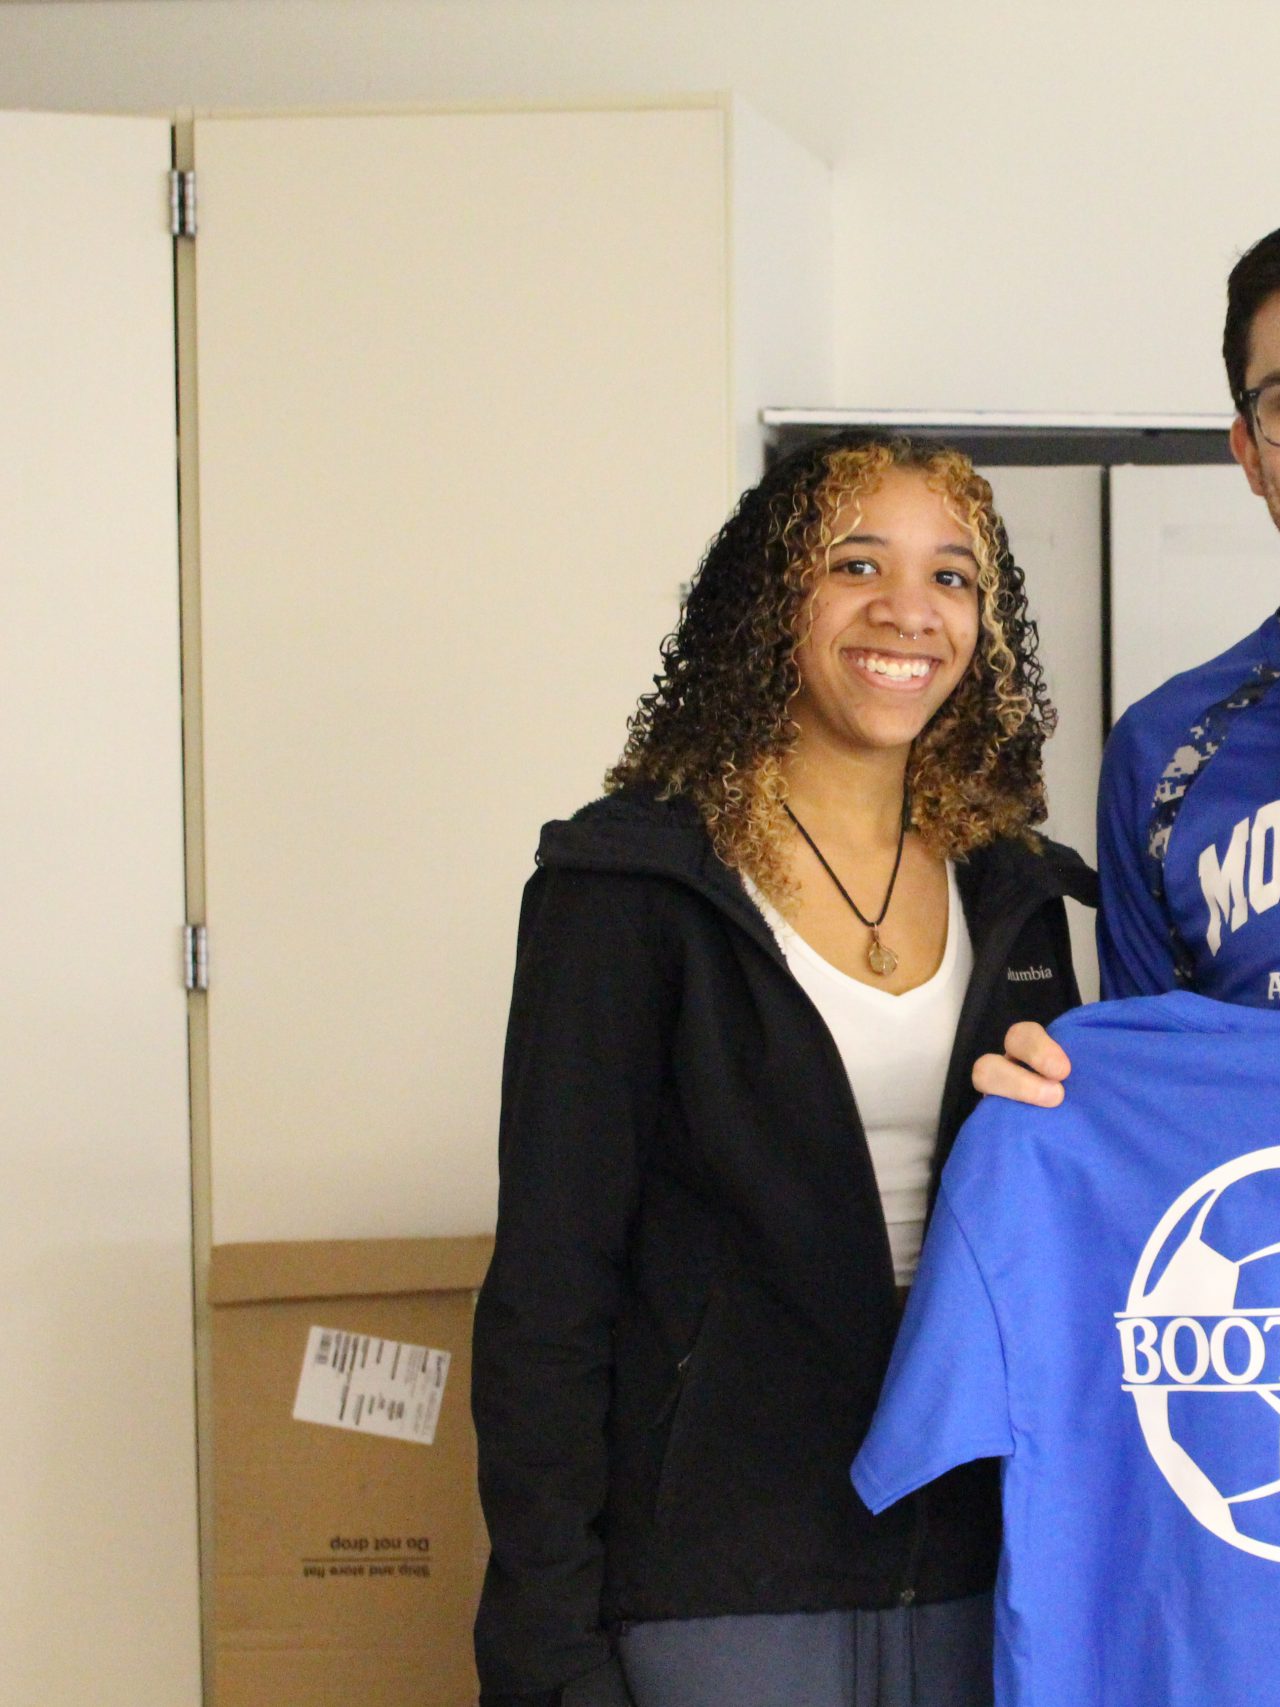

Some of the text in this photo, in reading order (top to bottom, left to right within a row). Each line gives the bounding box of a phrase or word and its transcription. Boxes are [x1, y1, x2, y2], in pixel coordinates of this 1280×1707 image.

[1008, 966, 1053, 981] lumbia
[329, 1536, 430, 1552] Do not drop
